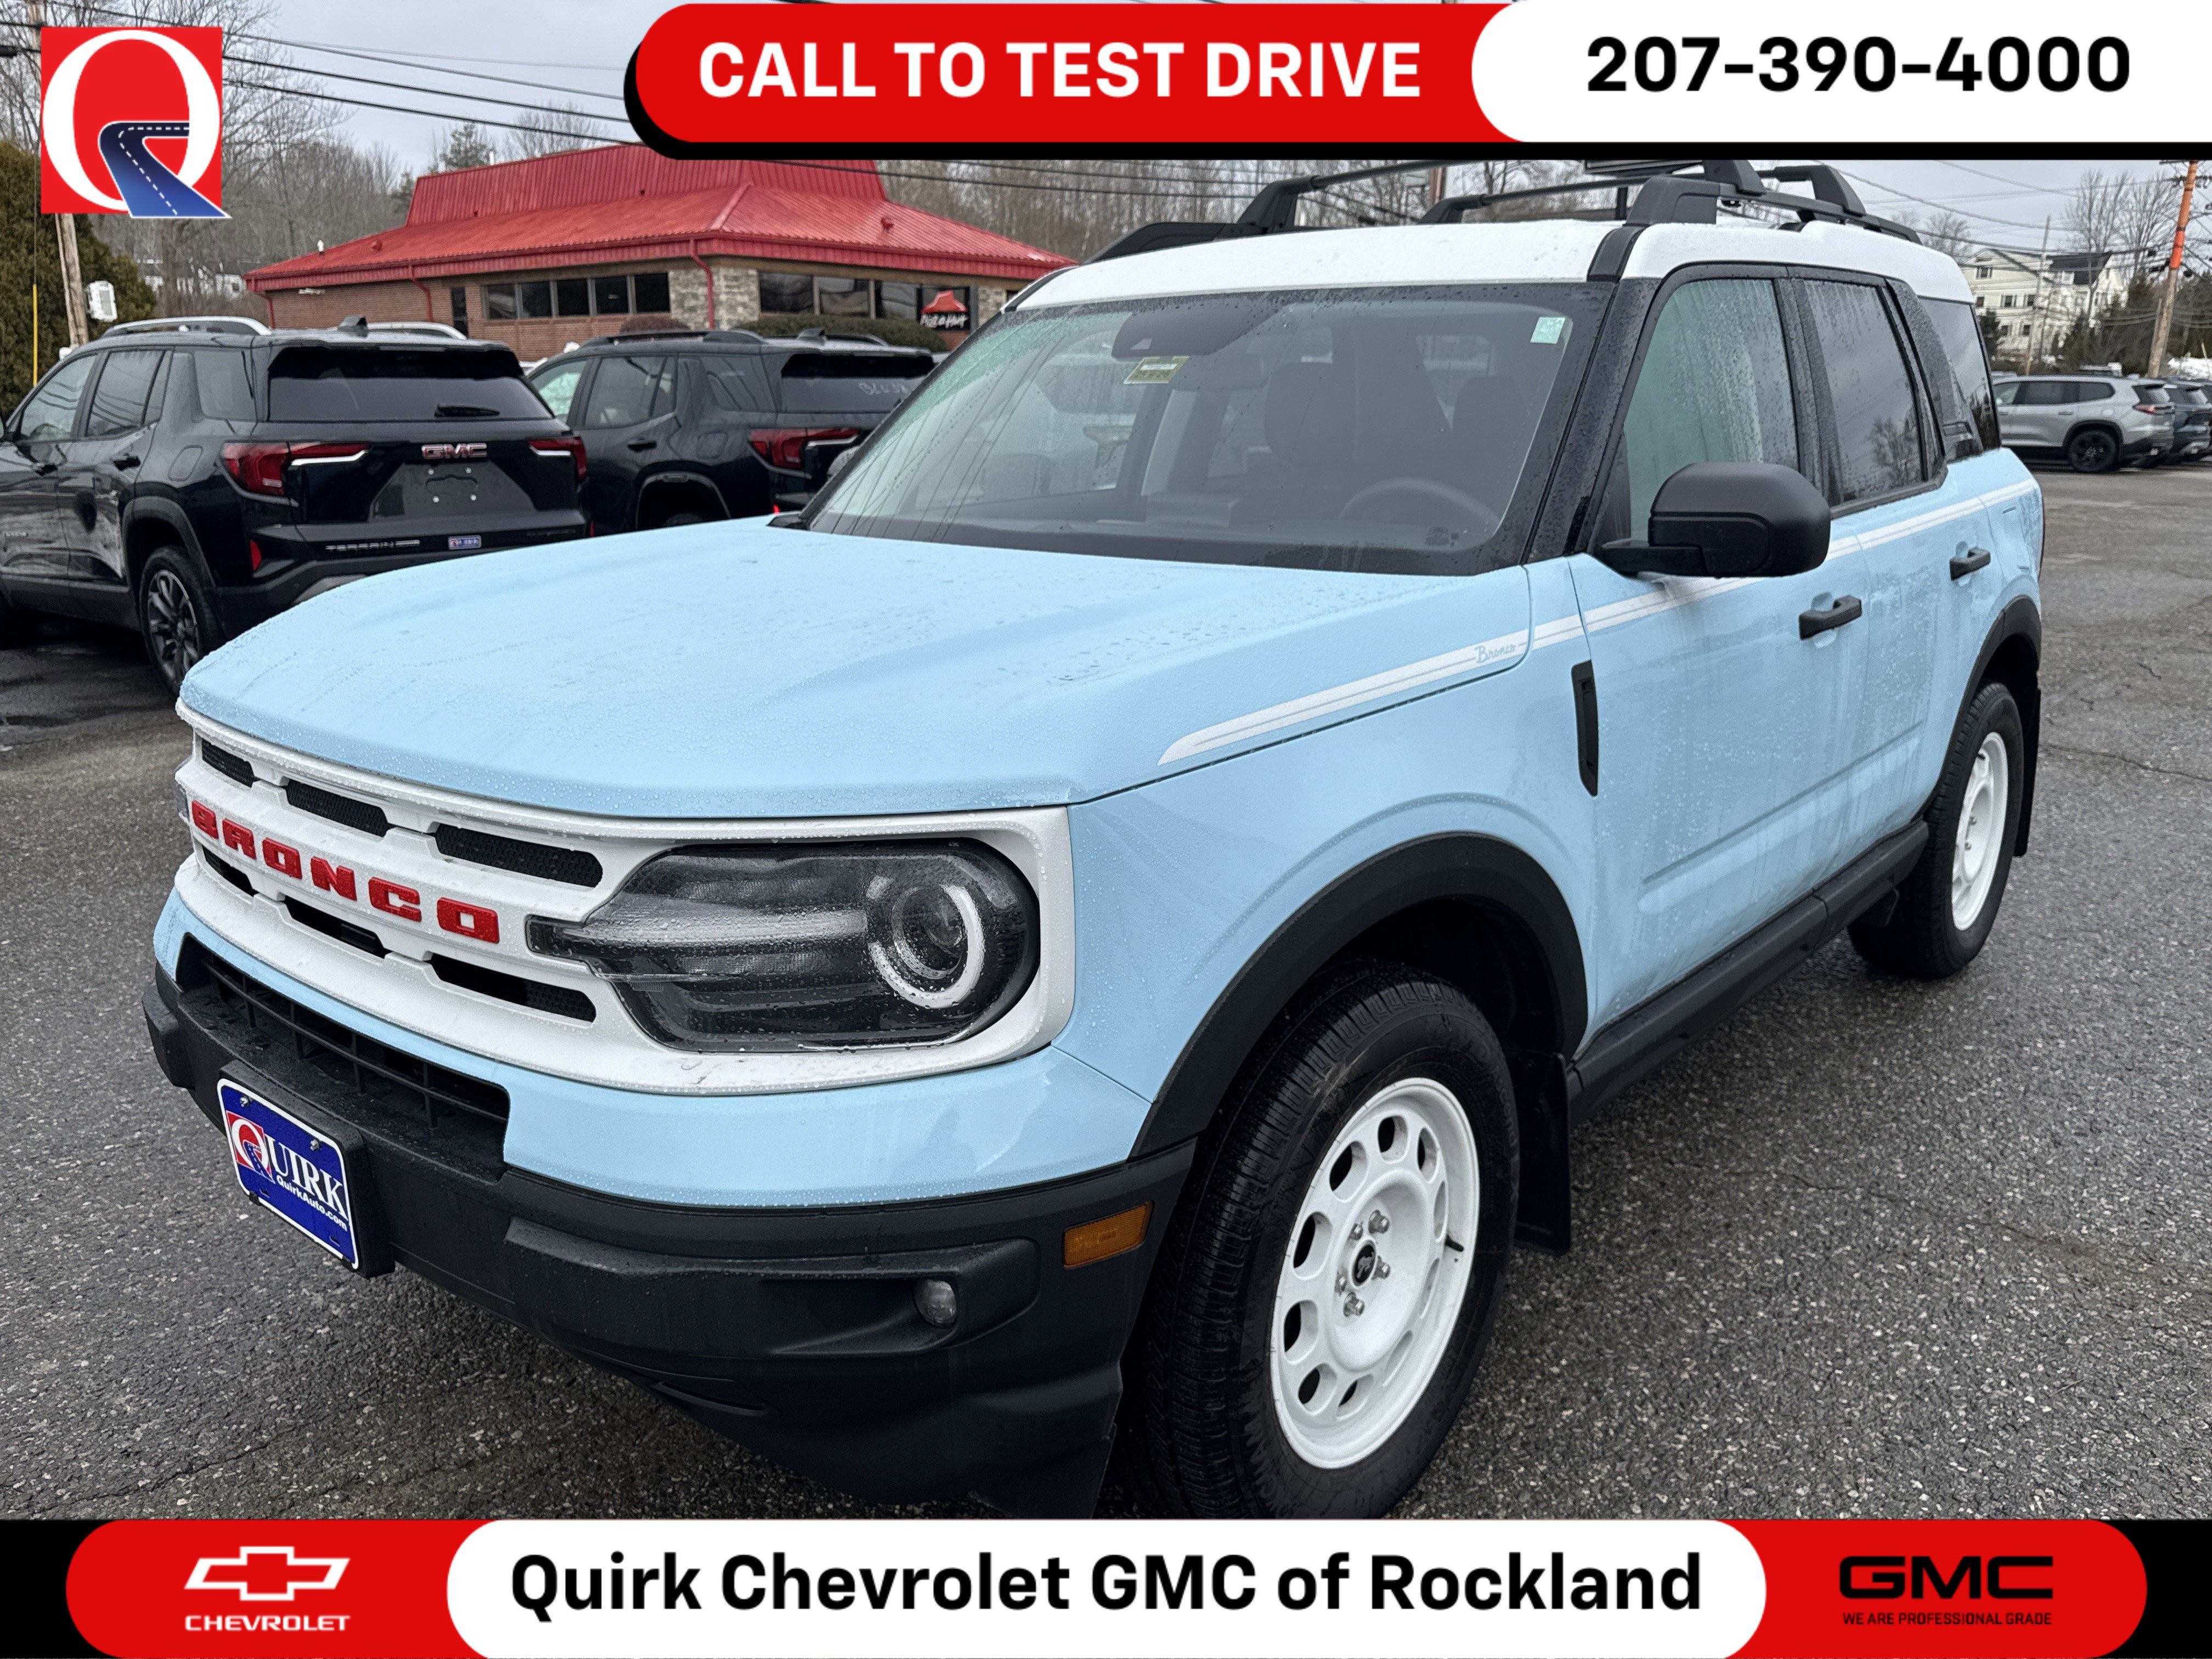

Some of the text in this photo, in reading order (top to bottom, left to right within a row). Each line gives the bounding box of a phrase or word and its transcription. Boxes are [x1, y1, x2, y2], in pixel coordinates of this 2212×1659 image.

[421, 443, 488, 459] GMC
[191, 800, 500, 944] BRONCO
[232, 1118, 349, 1221] QUIRK
[276, 1175, 347, 1232] QuirkAuto.com
